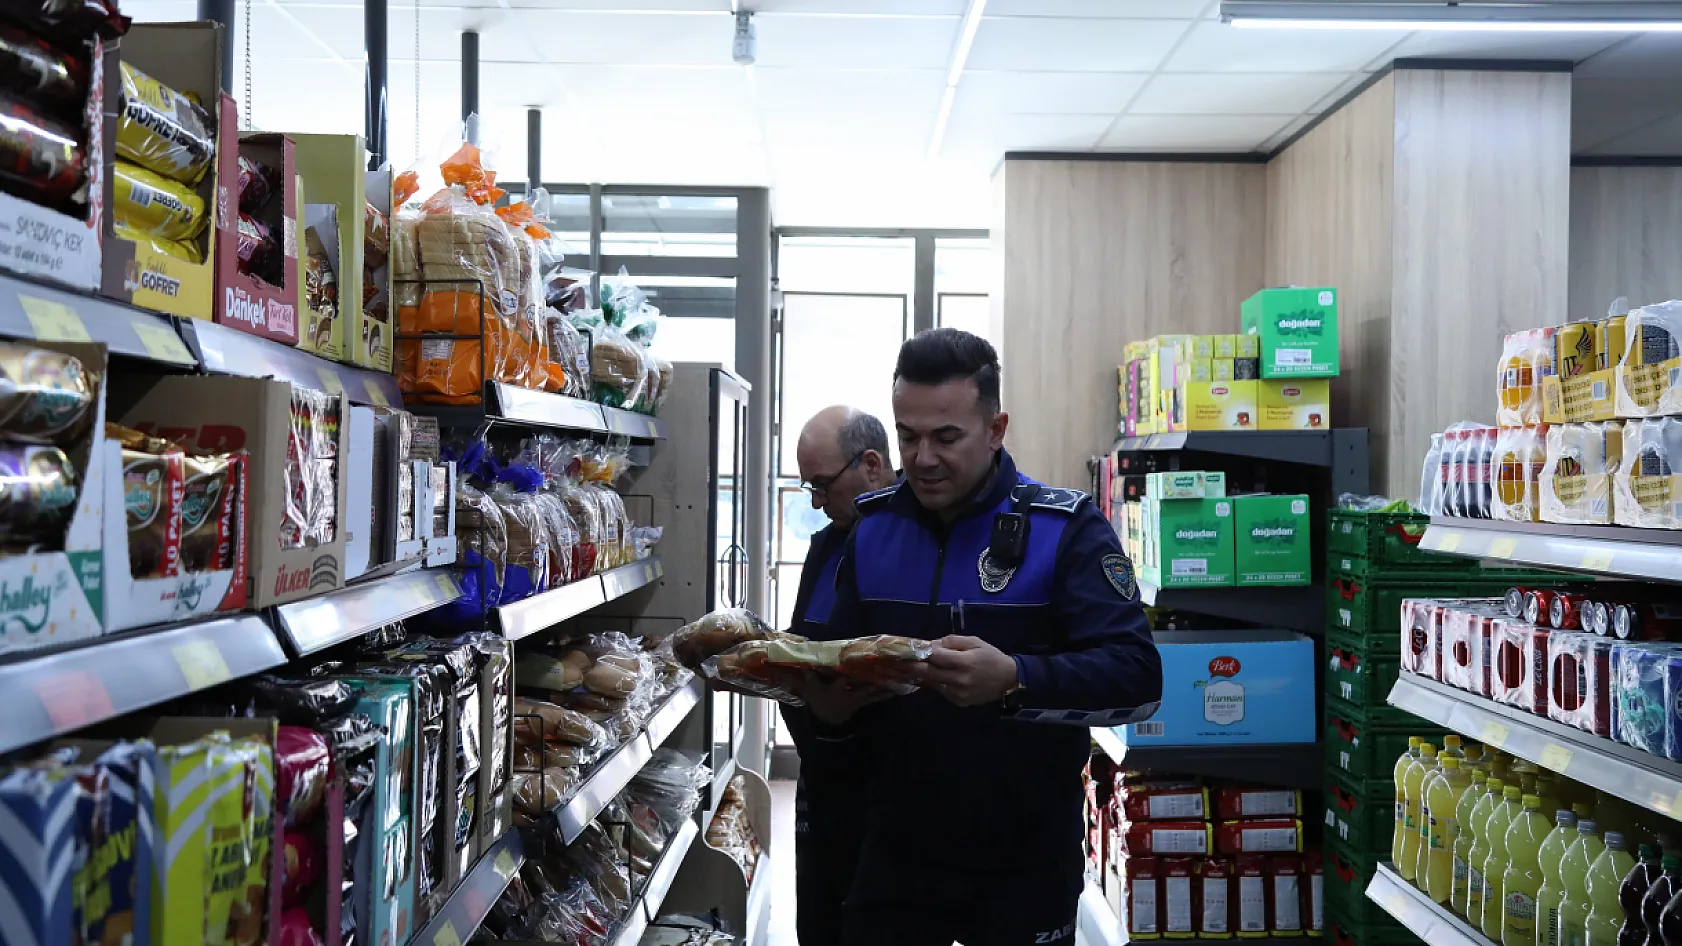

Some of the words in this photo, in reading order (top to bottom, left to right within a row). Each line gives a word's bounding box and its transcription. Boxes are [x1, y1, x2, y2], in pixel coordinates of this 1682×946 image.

[141, 271, 179, 297] GOFRET
[225, 287, 266, 328] Dankek
[1278, 319, 1321, 329] doğadan
[170, 480, 182, 540] PAKET
[1175, 530, 1217, 539] doğadan
[1252, 528, 1293, 537] doğadan
[274, 565, 310, 597] ÜLKER
[1206, 692, 1243, 702] Harman
